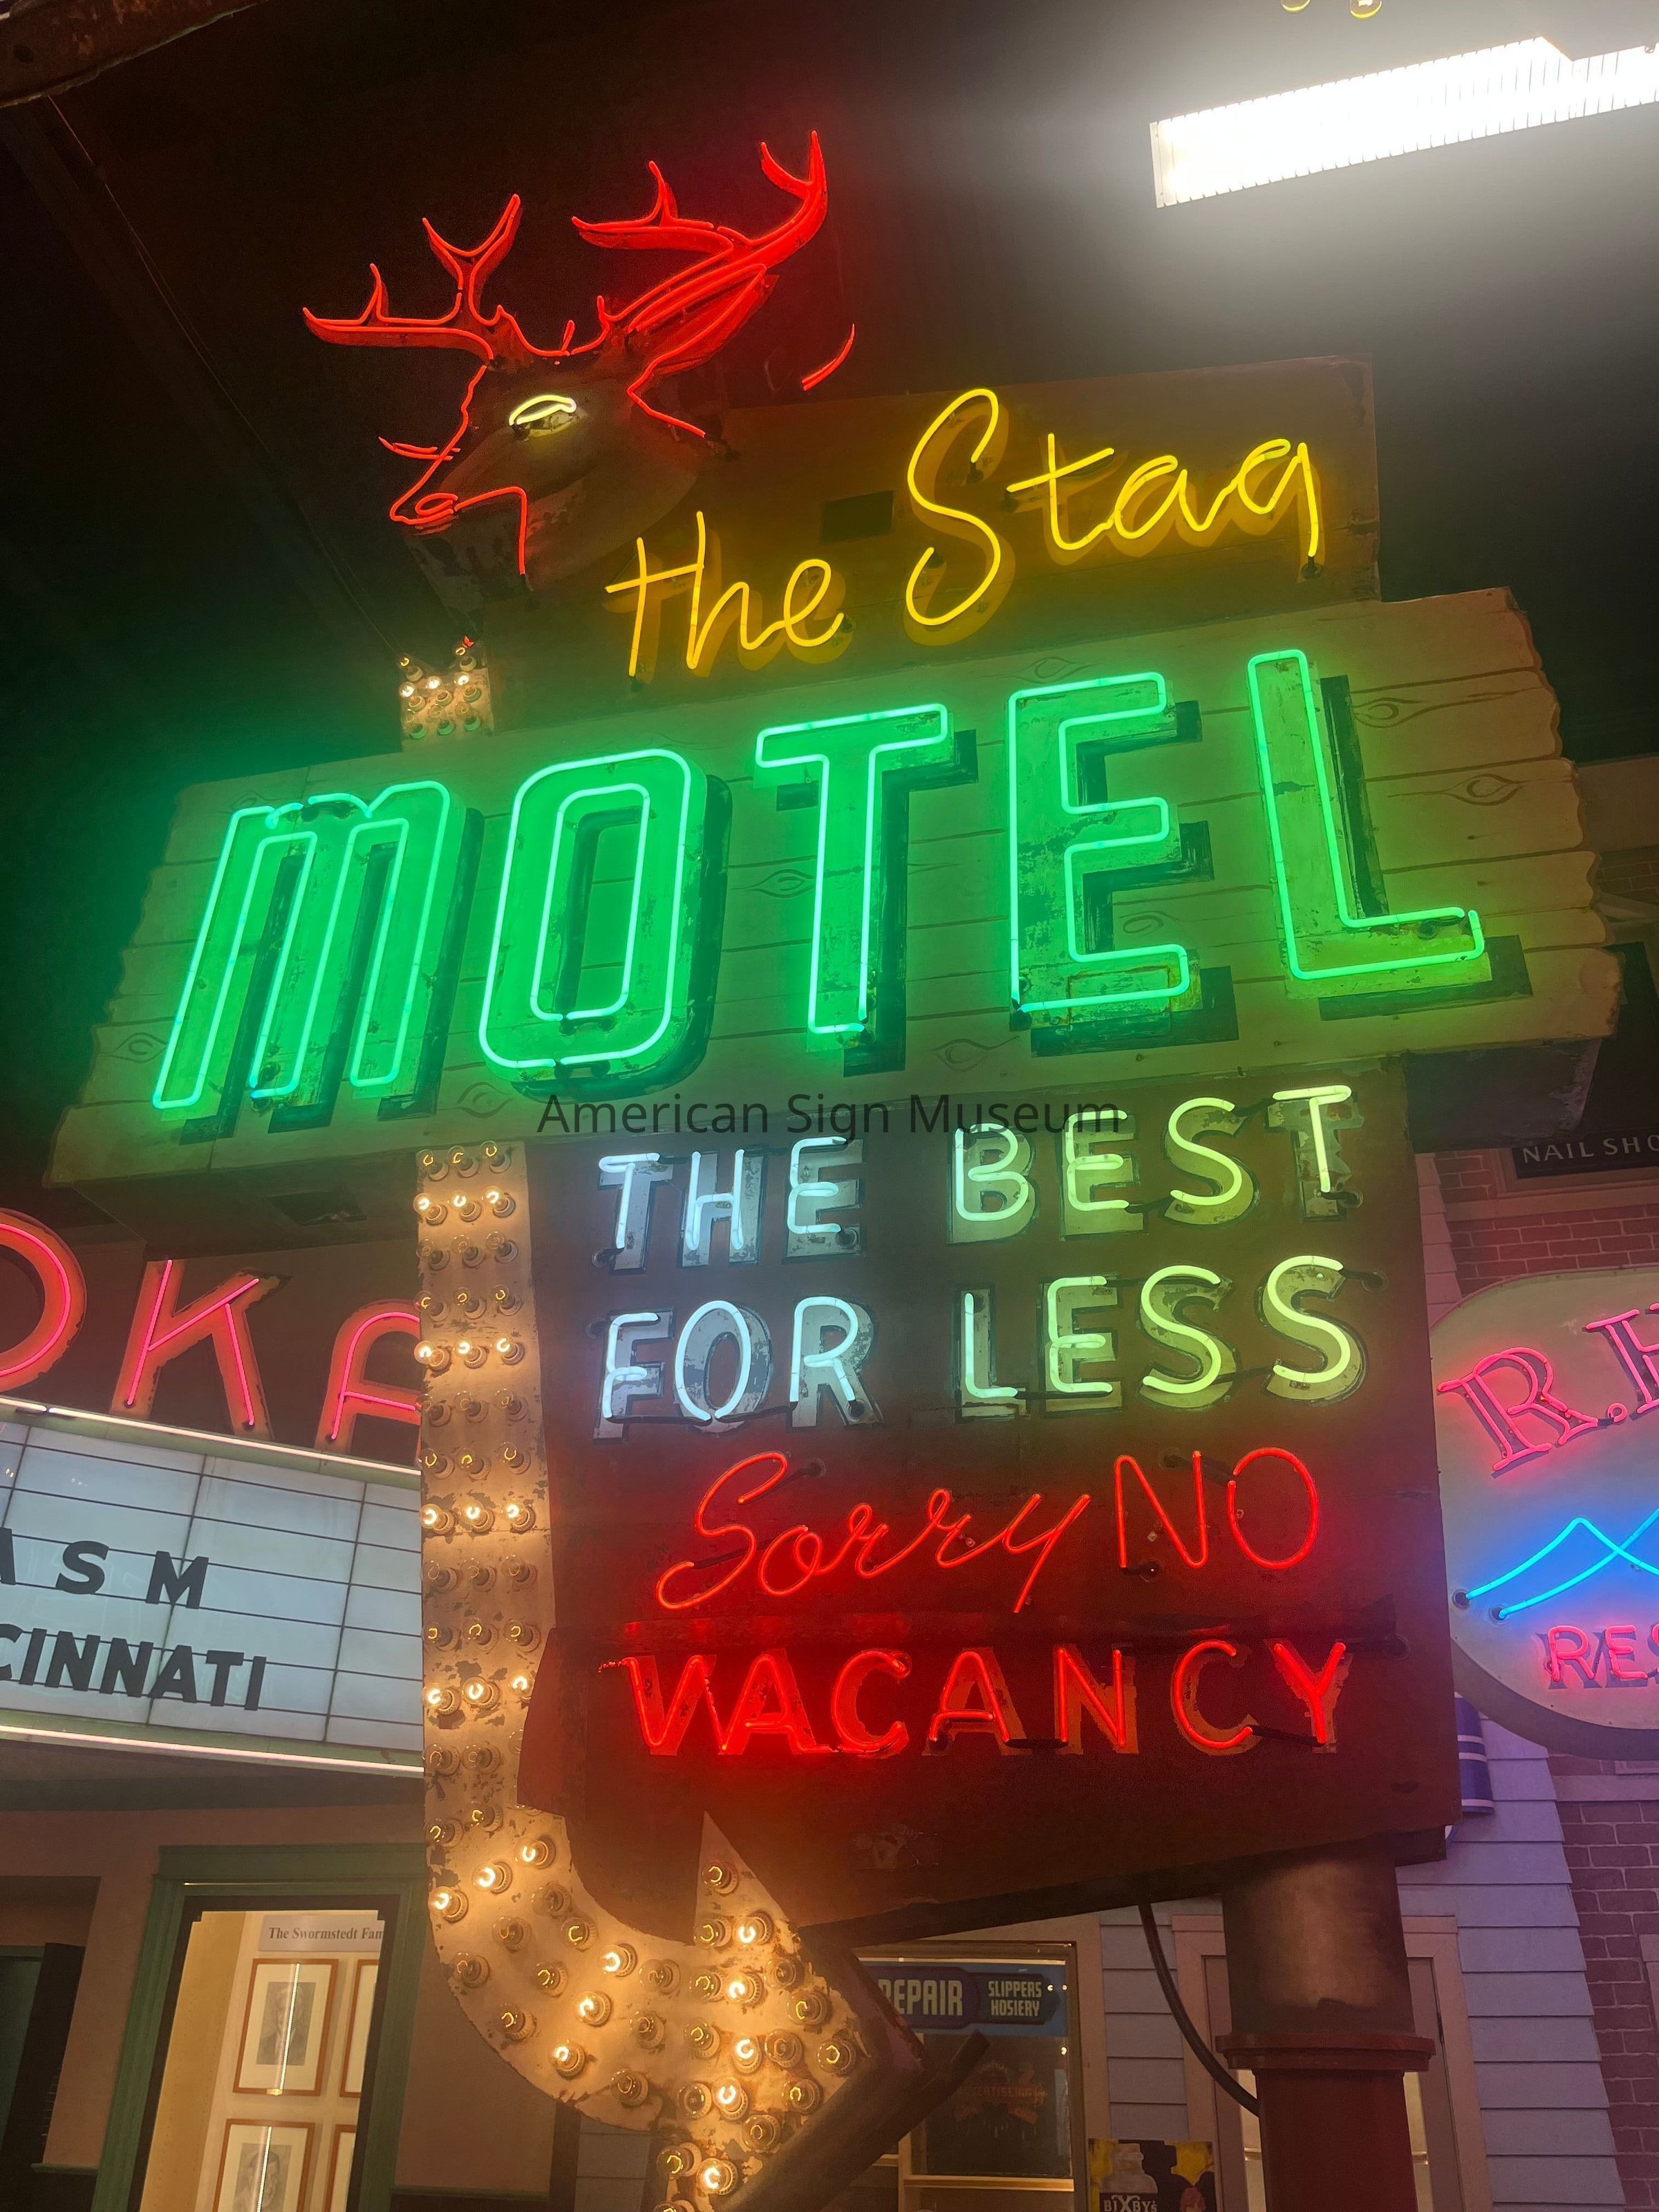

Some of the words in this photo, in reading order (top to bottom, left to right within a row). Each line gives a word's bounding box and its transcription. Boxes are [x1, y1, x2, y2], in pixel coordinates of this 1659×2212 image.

[605, 510, 845, 677] the
[906, 387, 1320, 628] Stag
[150, 646, 1490, 1113] MOTEL
[593, 1134, 865, 1273] THE
[948, 1084, 1363, 1243] BEST
[1523, 1142, 1595, 1163] NAIL
[593, 1296, 883, 1445] FOR
[953, 1255, 1367, 1421] LESS
[655, 1450, 1091, 1613] Sorry
[1113, 1446, 1318, 1569] NO
[617, 1638, 1353, 1756] VACANCY
[1540, 1623, 1659, 1689] RE
[268, 1927, 289, 1939] The
[292, 1927, 357, 1940] Swormstedt
[877, 1979, 963, 2016] REPAIR
[988, 1980, 1042, 1998] SLIPPERS
[991, 1999, 1040, 2016] HOSIERY
